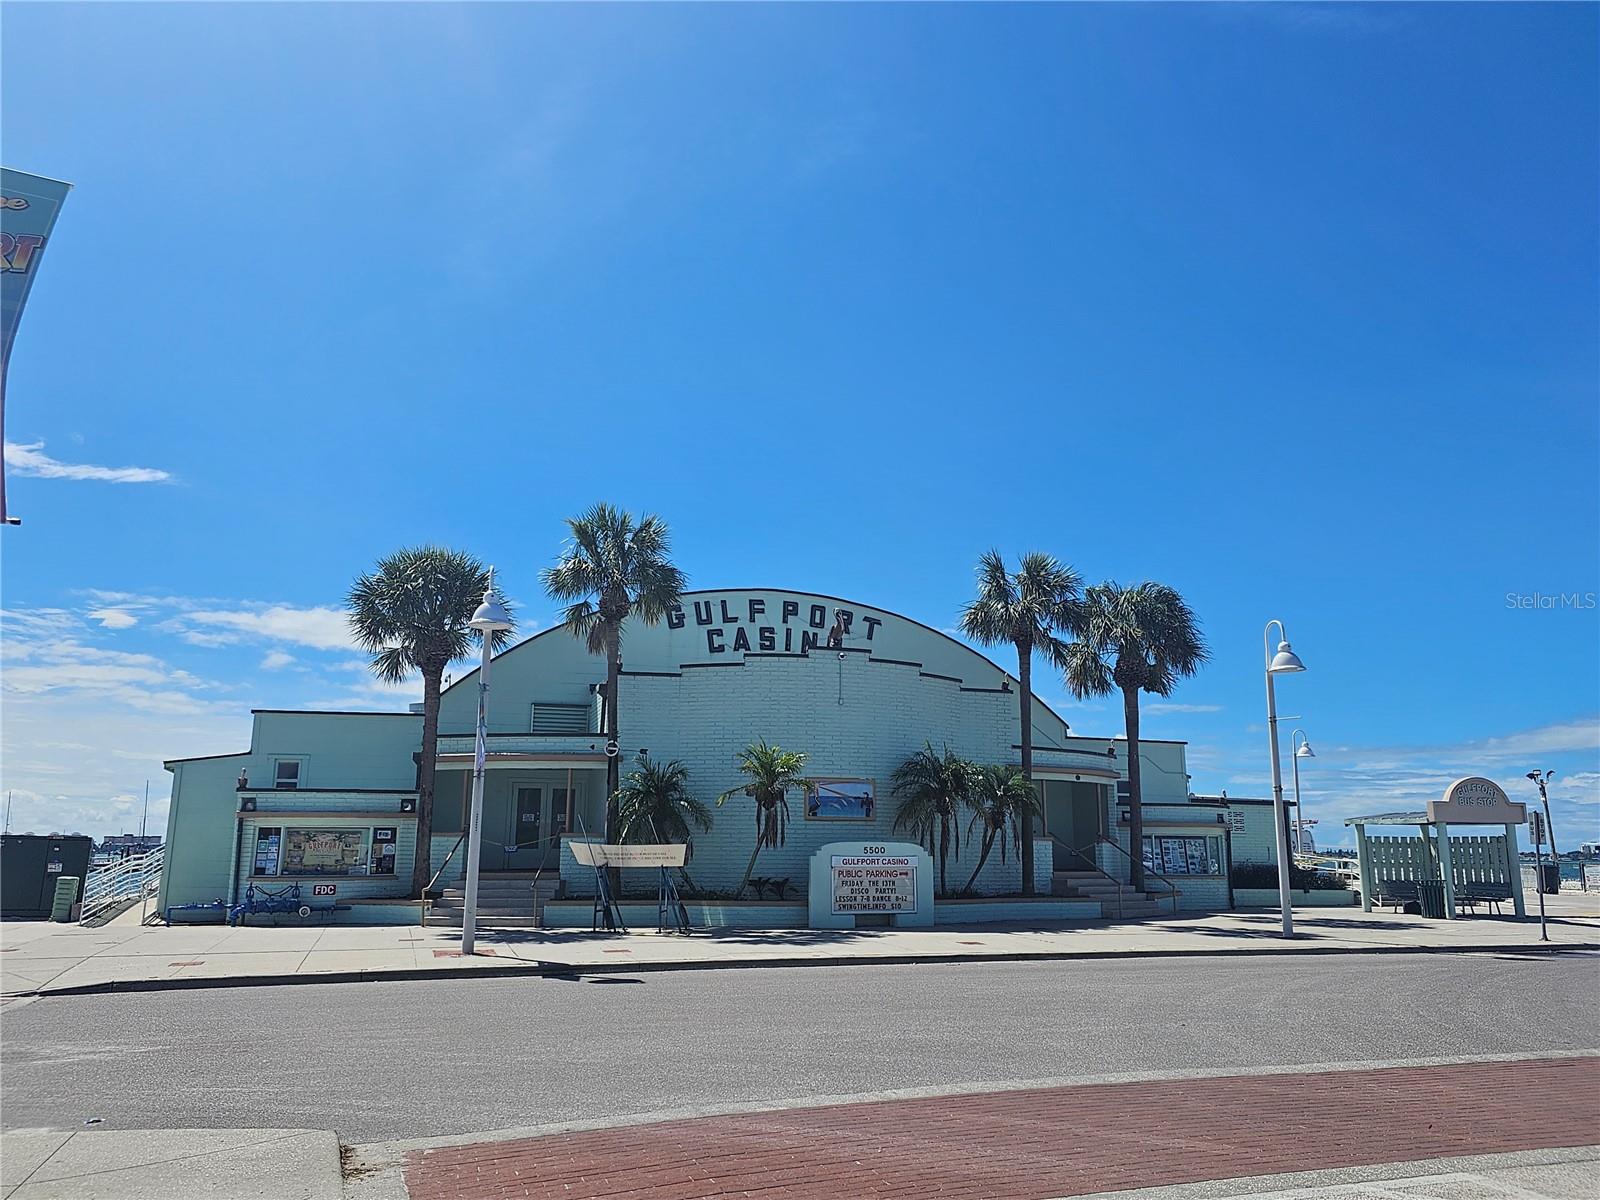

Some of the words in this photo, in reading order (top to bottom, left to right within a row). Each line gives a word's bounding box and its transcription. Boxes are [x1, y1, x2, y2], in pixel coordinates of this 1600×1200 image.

[666, 599, 883, 640] GULFPORT
[1457, 784, 1499, 797] GULFPORT
[1459, 797, 1475, 806] BUS
[1477, 797, 1498, 807] STOP
[863, 846, 886, 854] 5500
[842, 858, 881, 866] GULFPORT
[881, 858, 909, 866] CASINO
[838, 870, 863, 878] PUBLIC
[865, 870, 898, 878] PARKING
[315, 885, 335, 895] FDC
[850, 887, 870, 895] DISCO
[835, 895, 858, 903] LESSON
